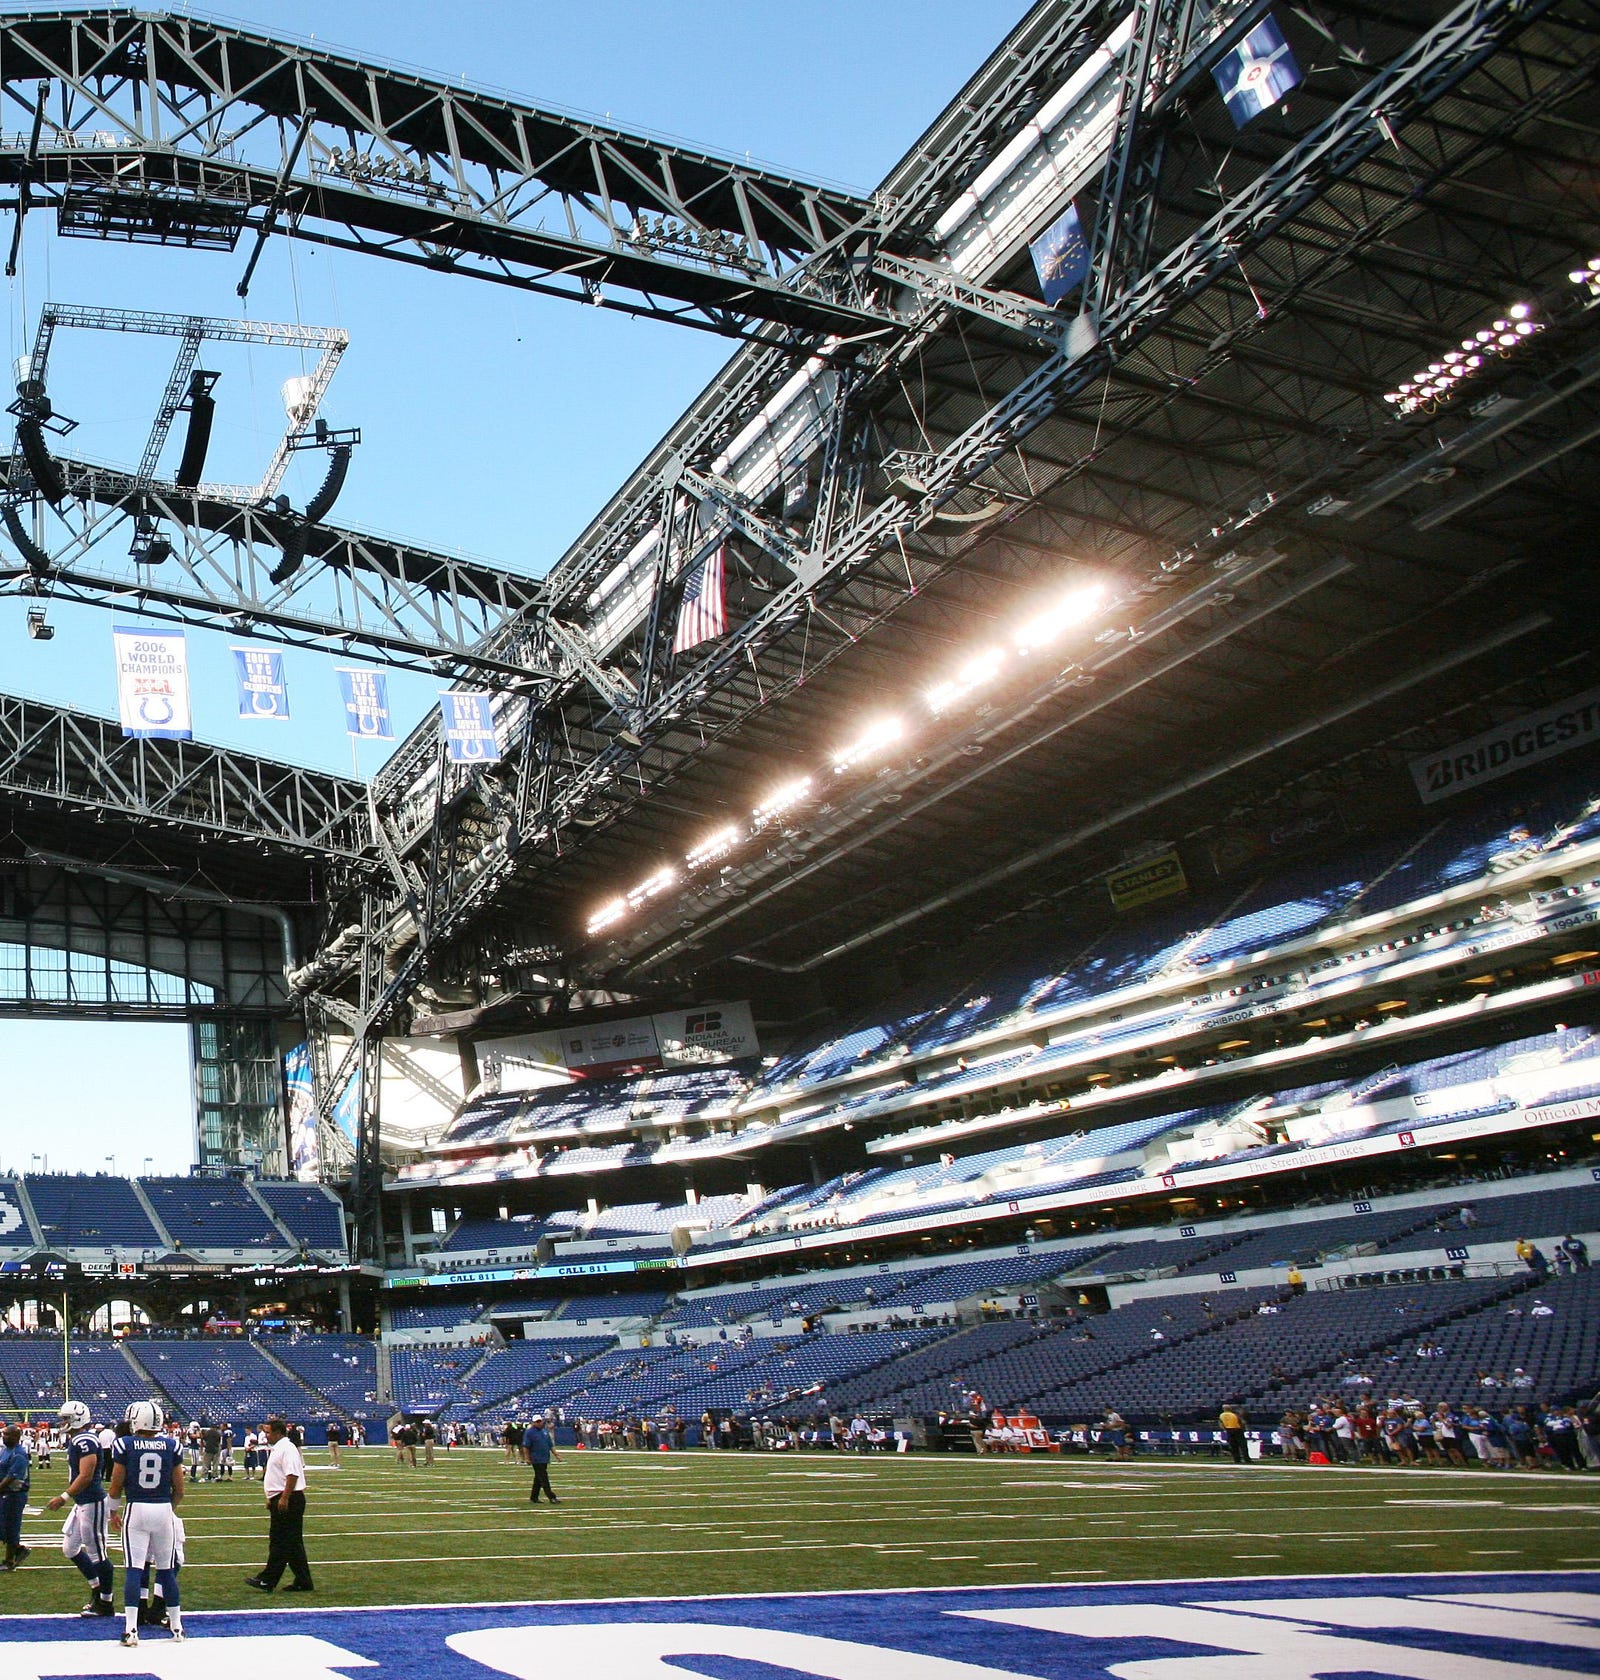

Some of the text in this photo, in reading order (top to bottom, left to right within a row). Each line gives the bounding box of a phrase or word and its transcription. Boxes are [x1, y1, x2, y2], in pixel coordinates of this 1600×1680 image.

[133, 641, 167, 653] 2006
[127, 652, 175, 664] WORLD
[121, 663, 183, 675] CHAMPIONS
[1426, 701, 1600, 792] BRIDGEST
[1115, 862, 1174, 892] STANLEY
[1459, 911, 1598, 958] JIM HARBAUGH 1994-97
[684, 1031, 728, 1043] INDIANA
[699, 1036, 746, 1050] BUREAU
[482, 1055, 535, 1080] Sprint
[1523, 1098, 1583, 1124] Official
[1246, 1142, 1366, 1173] The Strength it Takes
[1354, 1202, 1370, 1212] 212
[850, 1209, 982, 1238] Official Medical Partner of the Colts
[1181, 1226, 1195, 1237] 211
[1448, 1249, 1467, 1259] 113
[119, 1264, 134, 1273] 25
[143, 1263, 226, 1272] RAY'S TRASH SERVICE
[558, 1264, 609, 1275] CALL 811
[449, 1272, 497, 1283] CALL 811
[1220, 1274, 1235, 1283] 112
[1024, 1296, 1036, 1305] 111
[79, 1441, 89, 1453] 5
[133, 1439, 167, 1450] HARNISH
[138, 1452, 162, 1489] 8
